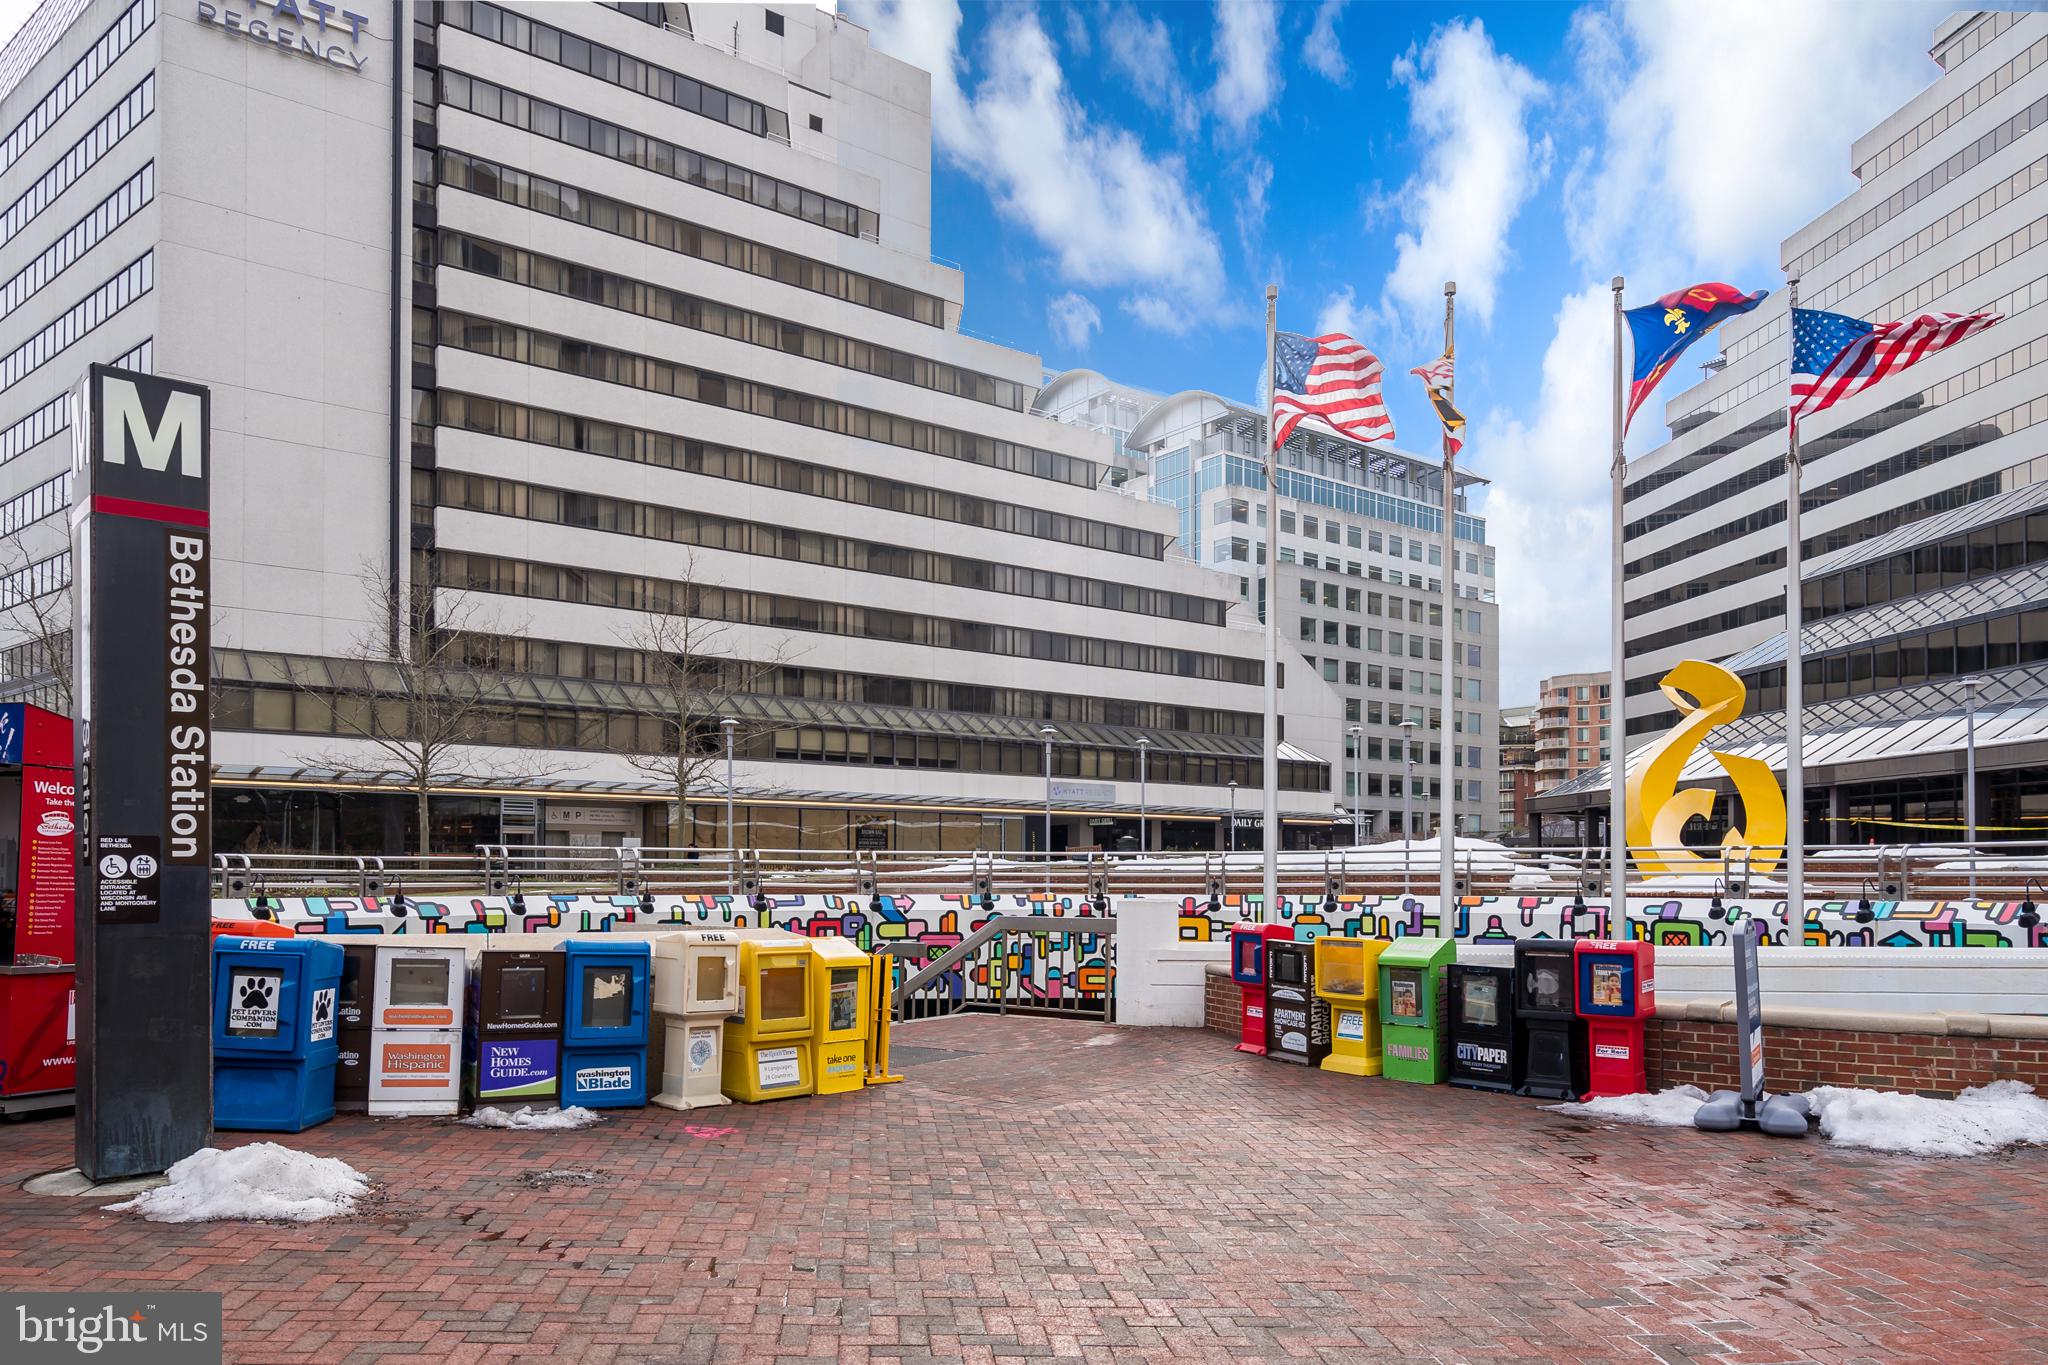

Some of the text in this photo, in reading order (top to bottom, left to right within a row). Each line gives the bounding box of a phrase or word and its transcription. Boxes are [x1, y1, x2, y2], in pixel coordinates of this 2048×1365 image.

[249, 0, 368, 44] ATT
[197, 1, 368, 73] REGENCY
[103, 375, 201, 478] M
[170, 535, 205, 858] Bethesda Station
[46, 798, 63, 806] Take
[1240, 923, 1257, 931] FREE
[701, 933, 726, 942] FREE
[240, 940, 277, 950] FREE
[338, 1007, 361, 1016] atino
[1274, 1007, 1306, 1021] APARTMENT
[1340, 1015, 1364, 1025] FREE
[487, 1021, 558, 1030] NewHomesGuide.com
[338, 1051, 359, 1060] atino
[388, 1052, 446, 1062] Washington
[491, 1047, 520, 1057] NEW
[1387, 1043, 1429, 1061] FAMILIES
[1456, 1044, 1507, 1064] CITYPAPER
[43, 1057, 76, 1067] www.
[490, 1057, 532, 1067] HOMES
[827, 1054, 856, 1064] take one
[387, 1060, 445, 1071] Hispanic
[490, 1067, 548, 1078] GUIDE.com
[577, 1069, 630, 1078] washington
[588, 1077, 630, 1090] Blade
